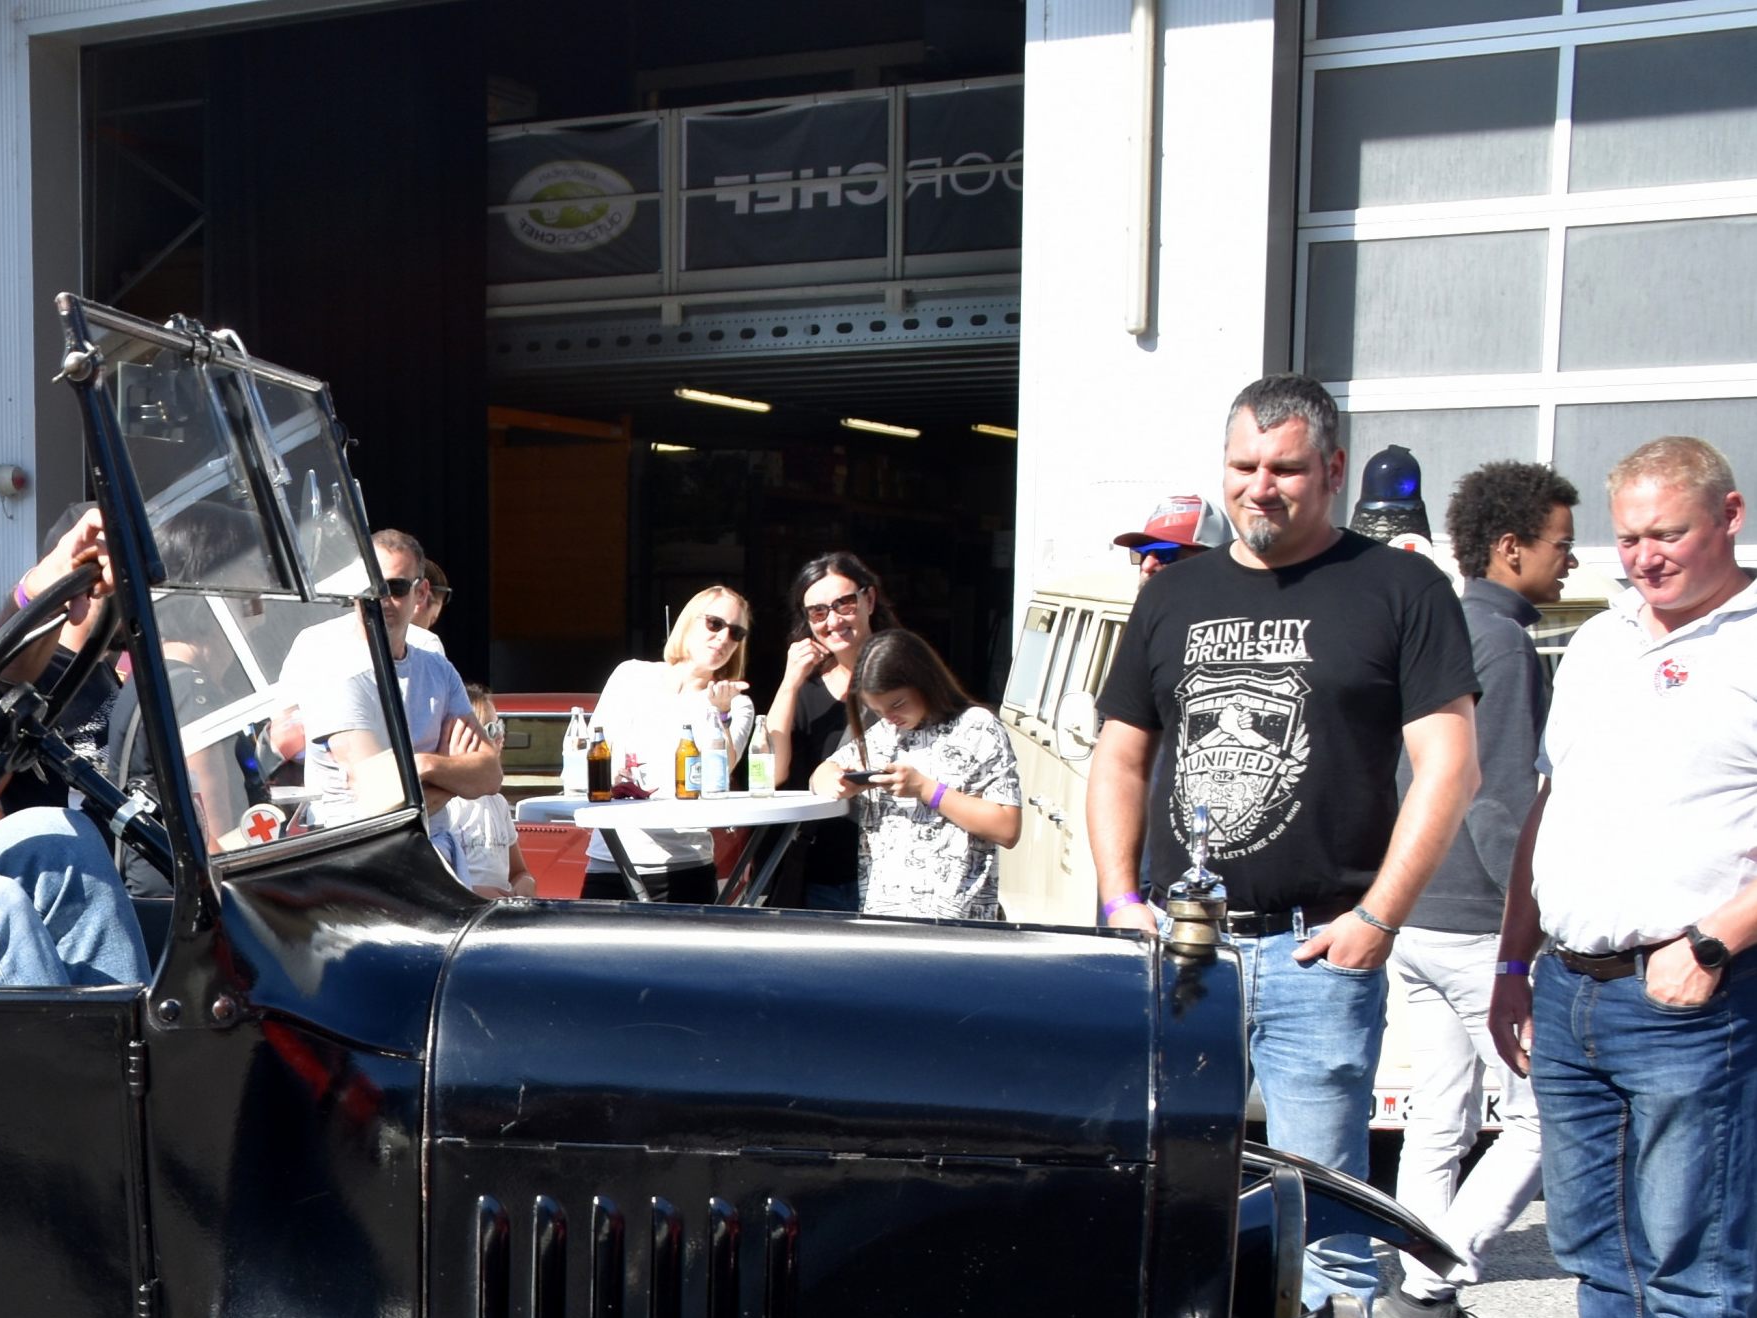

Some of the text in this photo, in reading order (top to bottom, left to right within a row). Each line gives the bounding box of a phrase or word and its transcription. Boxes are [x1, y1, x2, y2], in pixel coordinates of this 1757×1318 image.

[1189, 619, 1312, 648] SAINT CITY
[1183, 638, 1310, 666] ORCHESTRA
[1188, 751, 1276, 773] UNIFIED
[1222, 848, 1246, 860] LET'S
[1247, 837, 1269, 854] FREE
[1268, 823, 1287, 840] OUR
[1285, 800, 1302, 823] MIND
